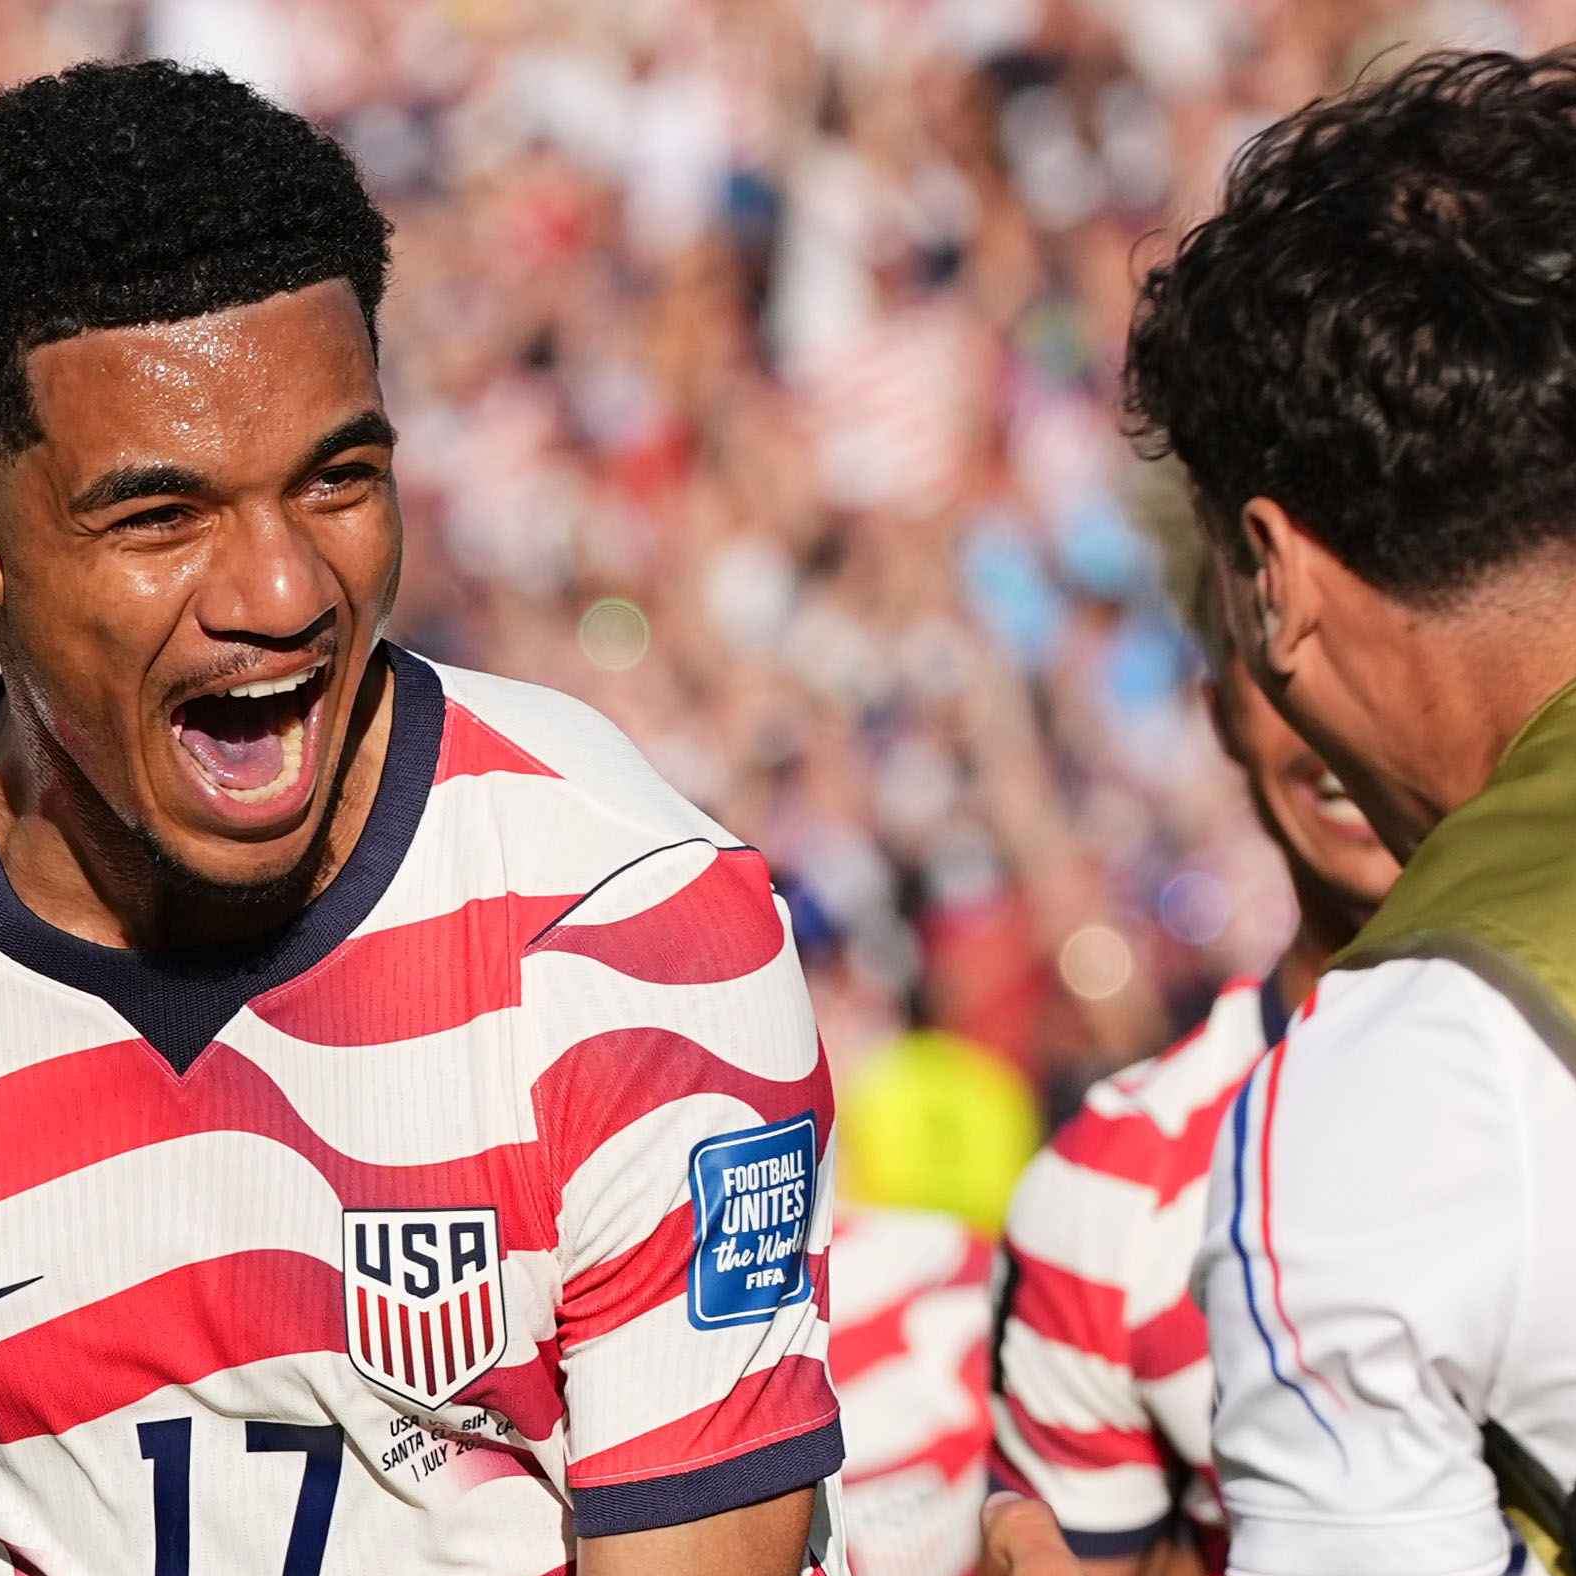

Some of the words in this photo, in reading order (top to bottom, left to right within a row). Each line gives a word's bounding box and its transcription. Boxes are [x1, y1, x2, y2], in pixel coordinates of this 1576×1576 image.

[722, 1150, 805, 1197] FOOTBALL
[721, 1180, 805, 1235] UNITES
[355, 1221, 486, 1299] USA
[712, 1237, 754, 1272] the
[746, 1268, 786, 1290] FIFA
[390, 1415, 420, 1437] USA
[462, 1410, 488, 1431] BIH
[382, 1431, 425, 1472] SANTA
[411, 1464, 420, 1483] 1
[422, 1443, 448, 1477] JULY
[456, 1440, 487, 1457] 202
